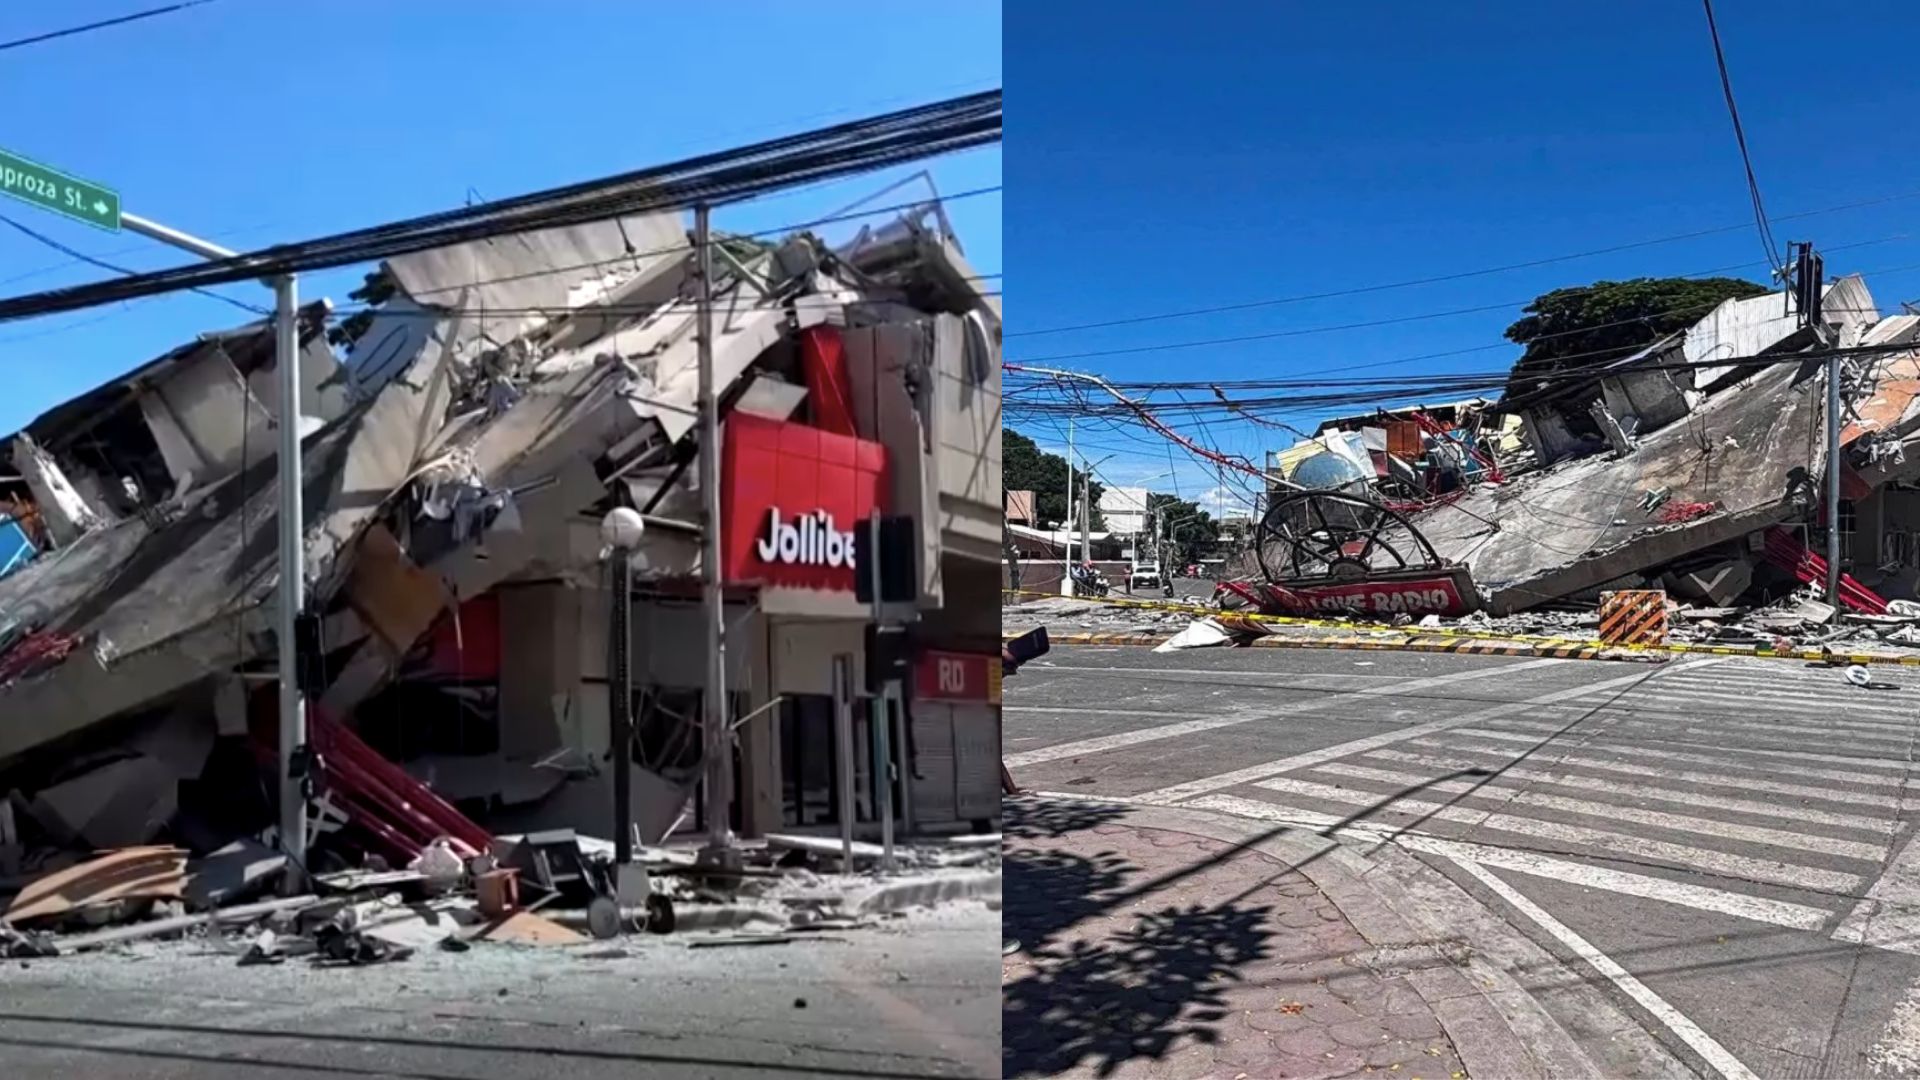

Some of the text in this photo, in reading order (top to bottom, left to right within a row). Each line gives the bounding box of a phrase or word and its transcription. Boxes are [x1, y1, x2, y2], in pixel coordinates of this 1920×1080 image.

[0, 166, 87, 210] proza St.
[1371, 590, 1450, 612] RADIO
[1823, 653, 1851, 663] CAUTION
[1869, 656, 1900, 665] CAUTION
[938, 658, 965, 693] RD
